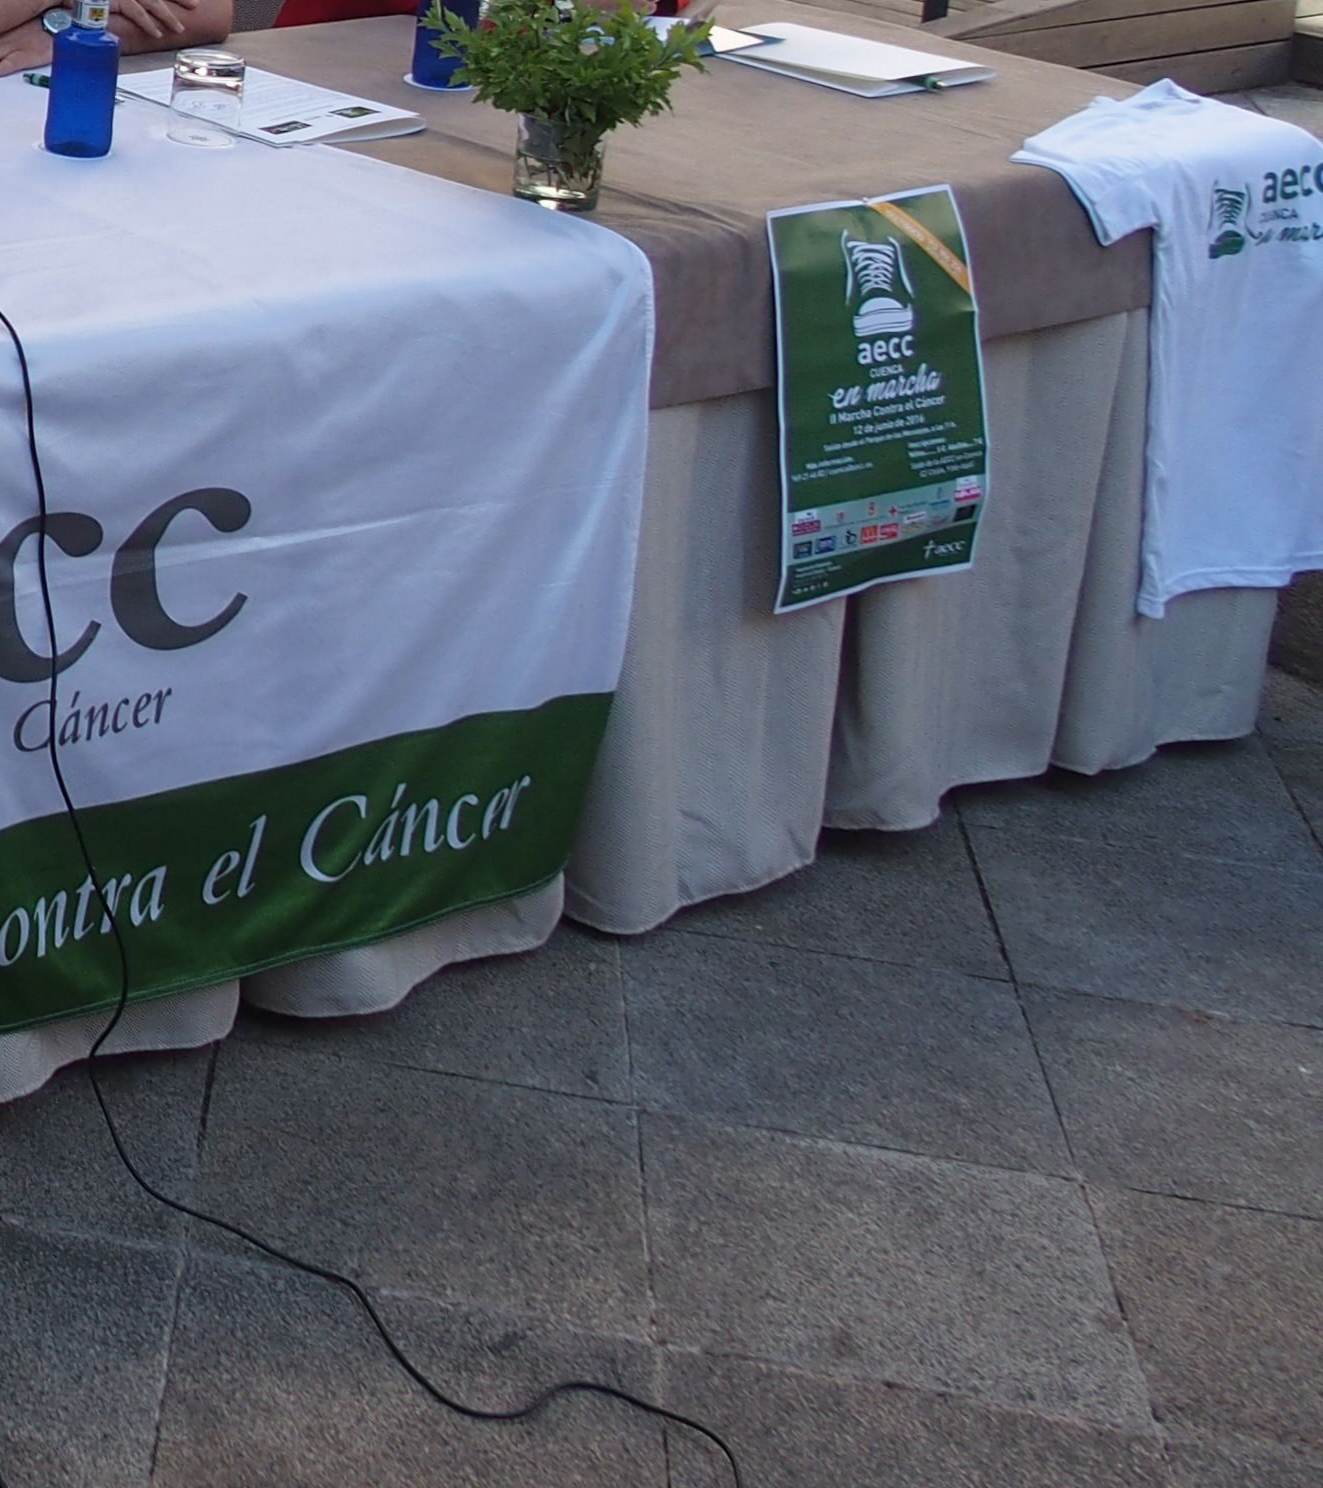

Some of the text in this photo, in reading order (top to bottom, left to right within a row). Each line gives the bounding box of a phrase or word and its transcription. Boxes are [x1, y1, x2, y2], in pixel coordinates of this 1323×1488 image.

[857, 334, 914, 365] aecc
[869, 364, 904, 379] CUENCA
[828, 363, 944, 409] en marcha
[12, 681, 173, 754] Cáncer
[201, 814, 267, 906] el
[297, 770, 534, 885] Cáncer
